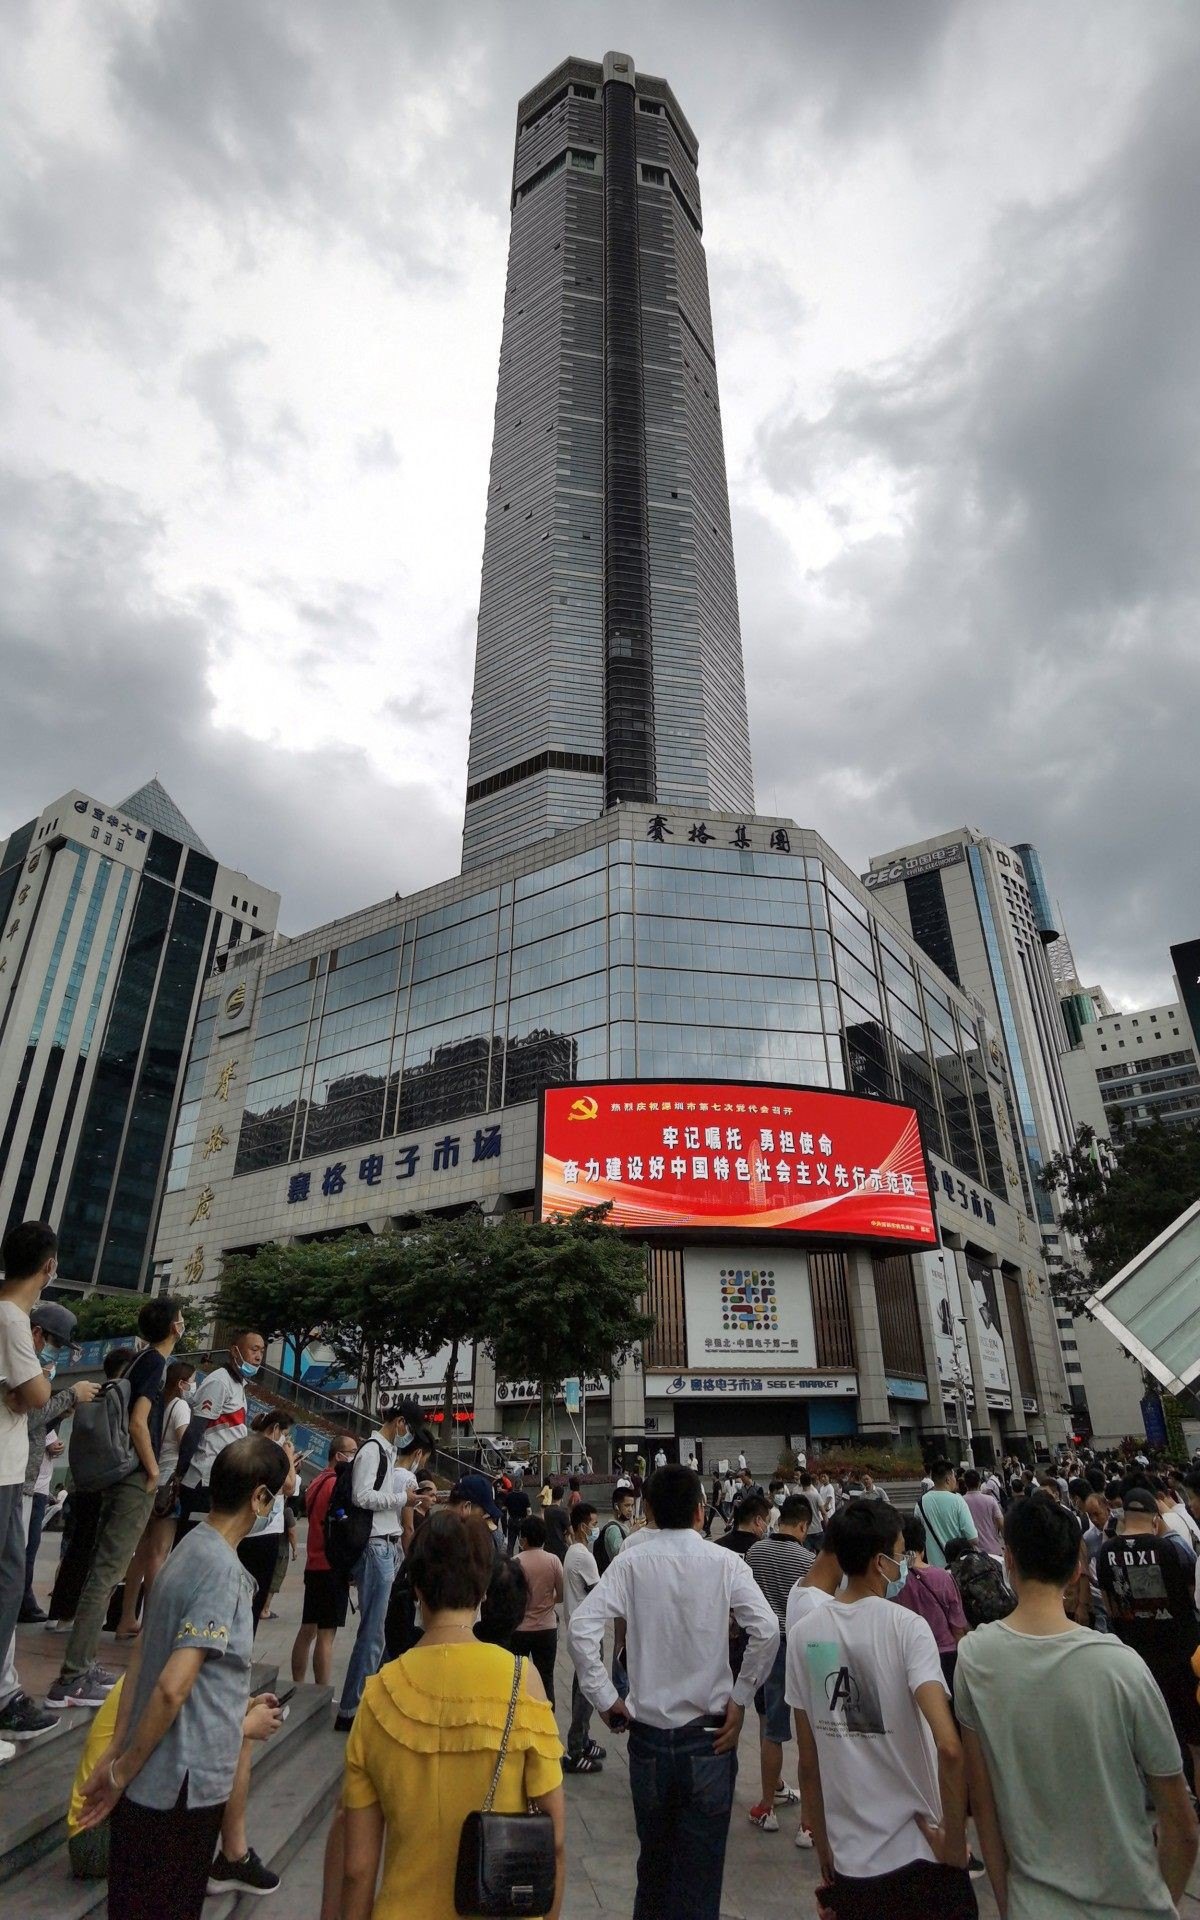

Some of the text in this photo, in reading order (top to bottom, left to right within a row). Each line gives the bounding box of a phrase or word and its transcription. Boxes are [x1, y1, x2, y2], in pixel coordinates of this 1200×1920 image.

[864, 865, 904, 887] CEC
[662, 1126, 832, 1157] 牢记嘱托 勇担使命
[287, 1125, 502, 1204] 赛格电子市场
[563, 1155, 915, 1196] 奋力建设好中国特色社会主义先行示范区
[691, 1378, 763, 1391] 赛格电子市场
[767, 1380, 839, 1389] SEG E-MARKET
